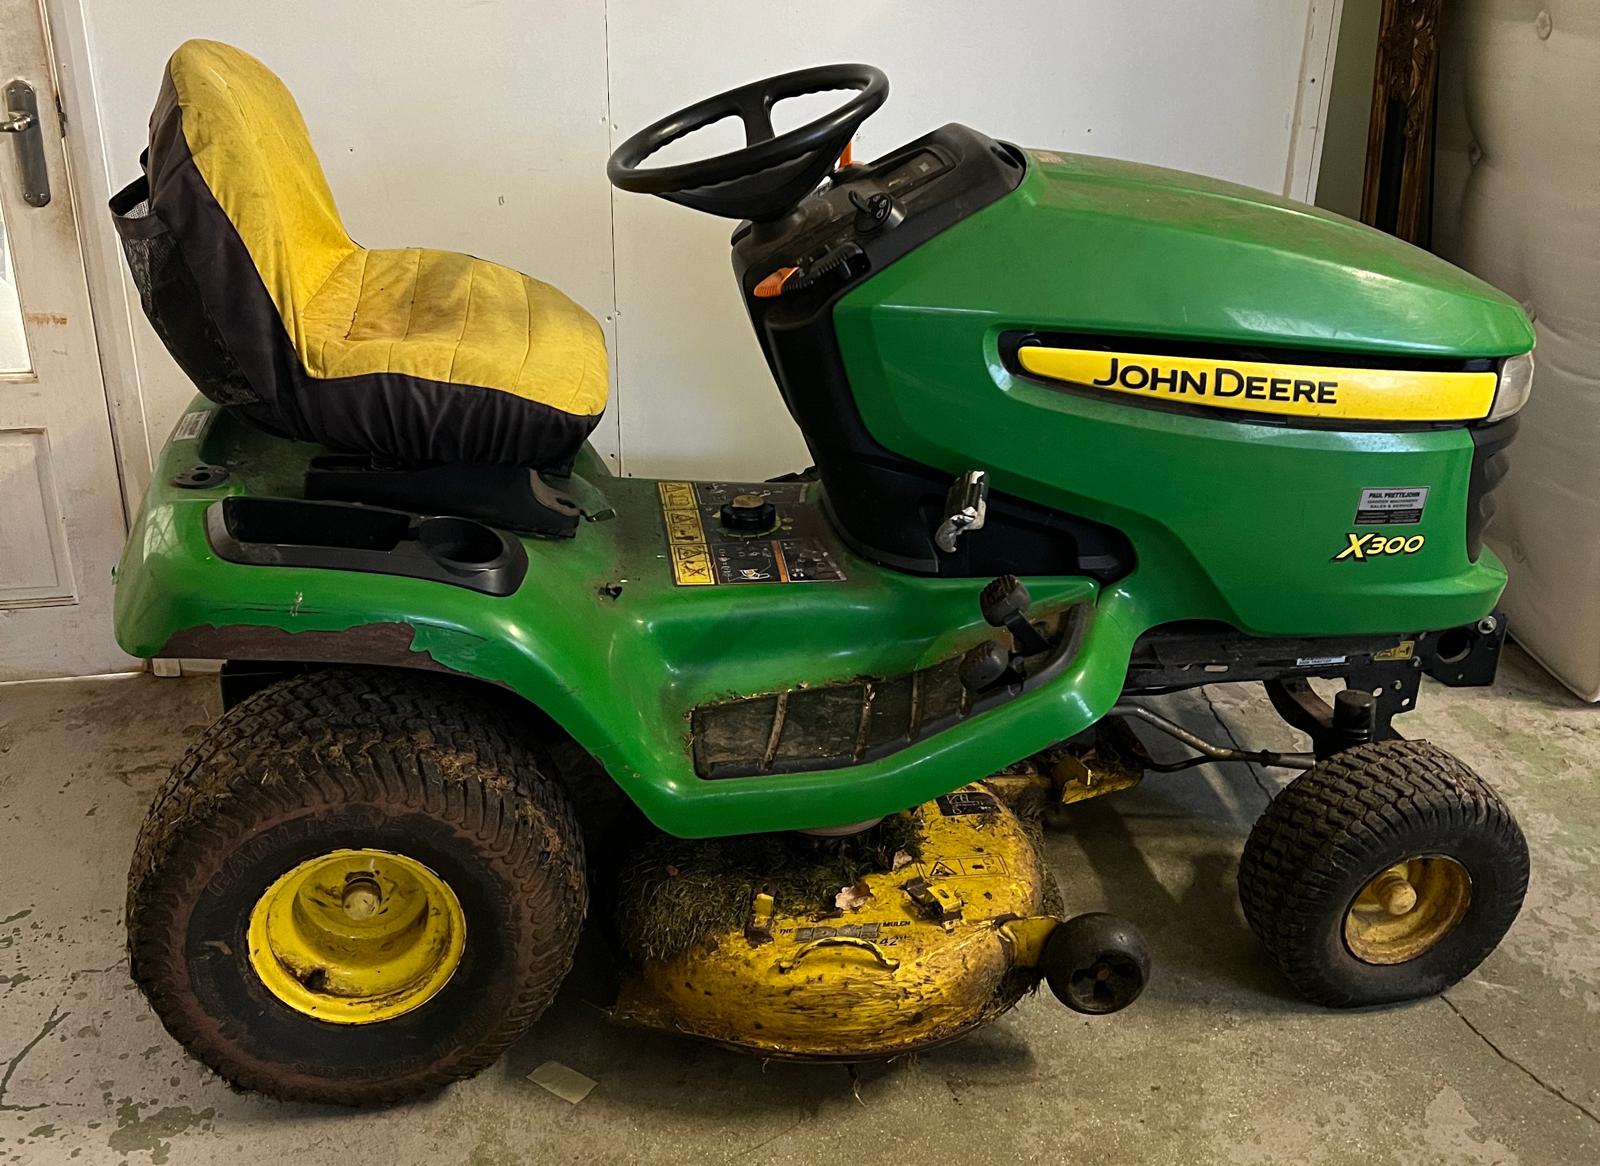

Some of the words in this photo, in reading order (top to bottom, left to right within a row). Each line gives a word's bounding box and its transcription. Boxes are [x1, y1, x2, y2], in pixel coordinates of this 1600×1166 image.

[1093, 357, 1207, 395] JOHN
[1213, 367, 1338, 404] DEERE
[1332, 532, 1425, 561] X300
